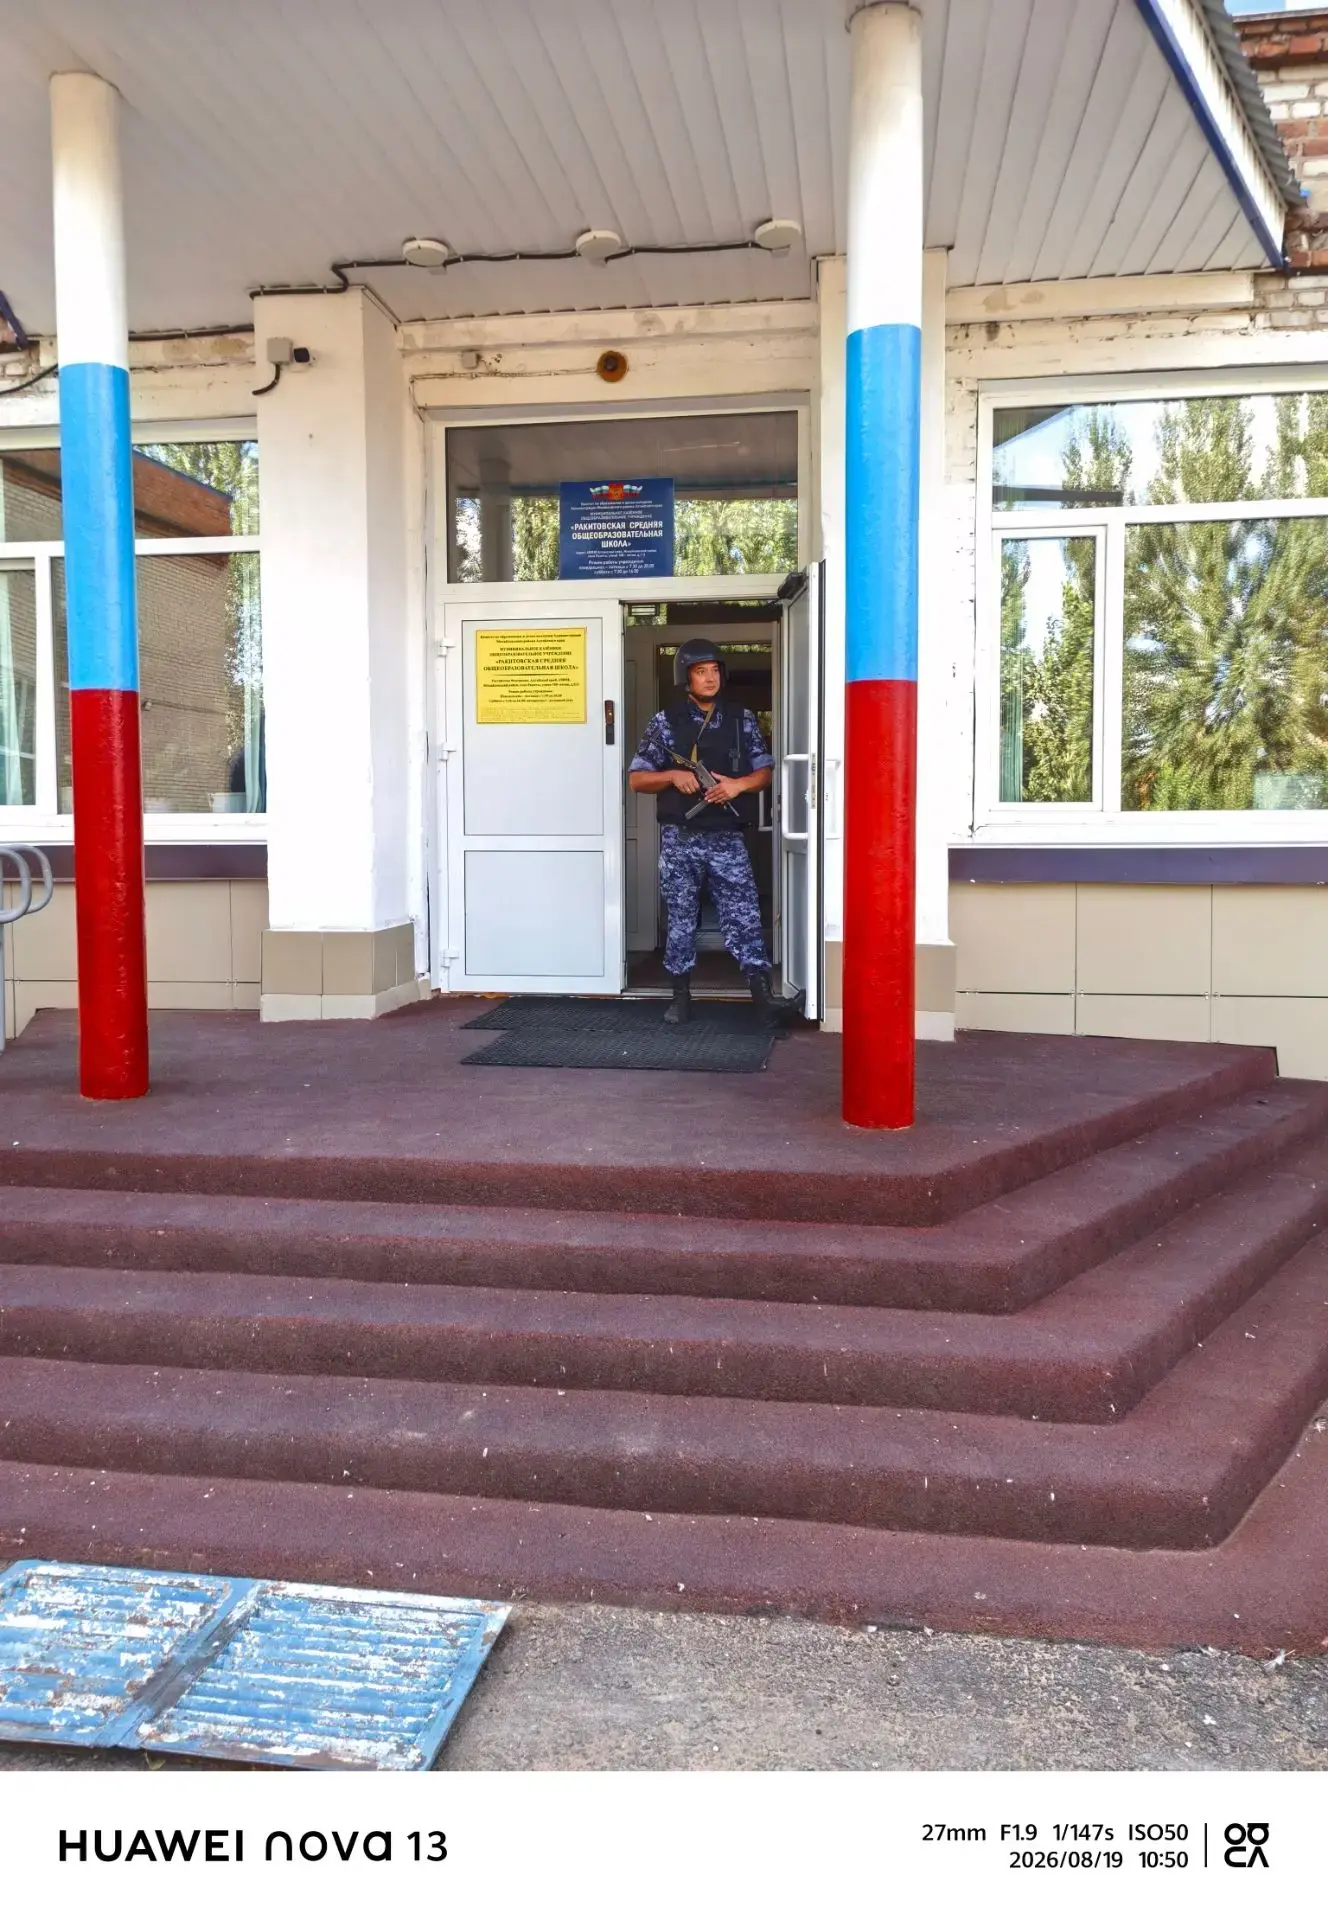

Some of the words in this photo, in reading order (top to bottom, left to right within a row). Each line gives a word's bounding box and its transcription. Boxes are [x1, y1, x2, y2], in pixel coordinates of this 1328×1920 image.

[571, 523, 626, 531] «РАКИТОВСКАЯ
[629, 521, 663, 529] СРЕДНЯЯ
[572, 530, 663, 540] ОБЩЕОБРАЗОВАТЕЛЬНАЯ
[601, 540, 632, 548] ШКОЛА»
